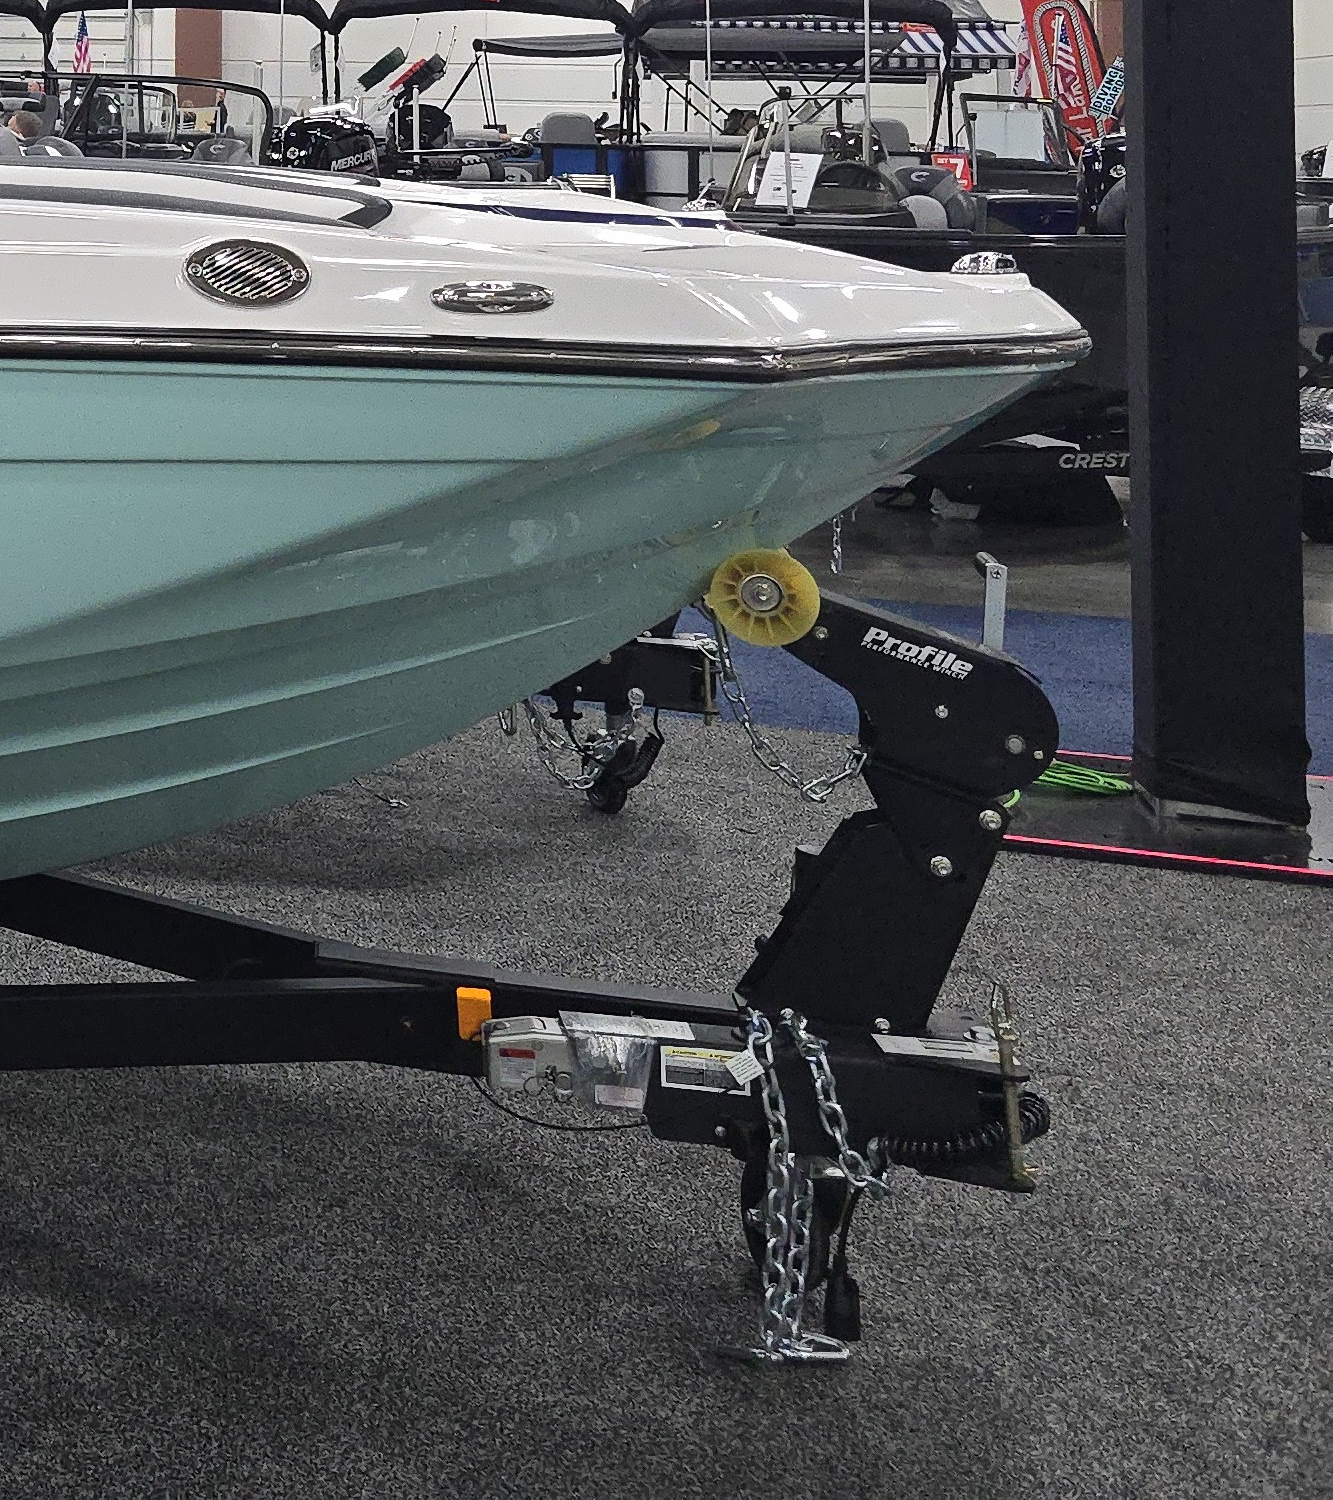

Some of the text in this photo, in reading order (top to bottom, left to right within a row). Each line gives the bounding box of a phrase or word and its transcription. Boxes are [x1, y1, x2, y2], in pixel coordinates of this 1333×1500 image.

[1092, 70, 1118, 109] DIVING
[1058, 452, 1131, 469] CREST
[860, 640, 930, 669] PERFORMANCE
[862, 626, 974, 672] Profile
